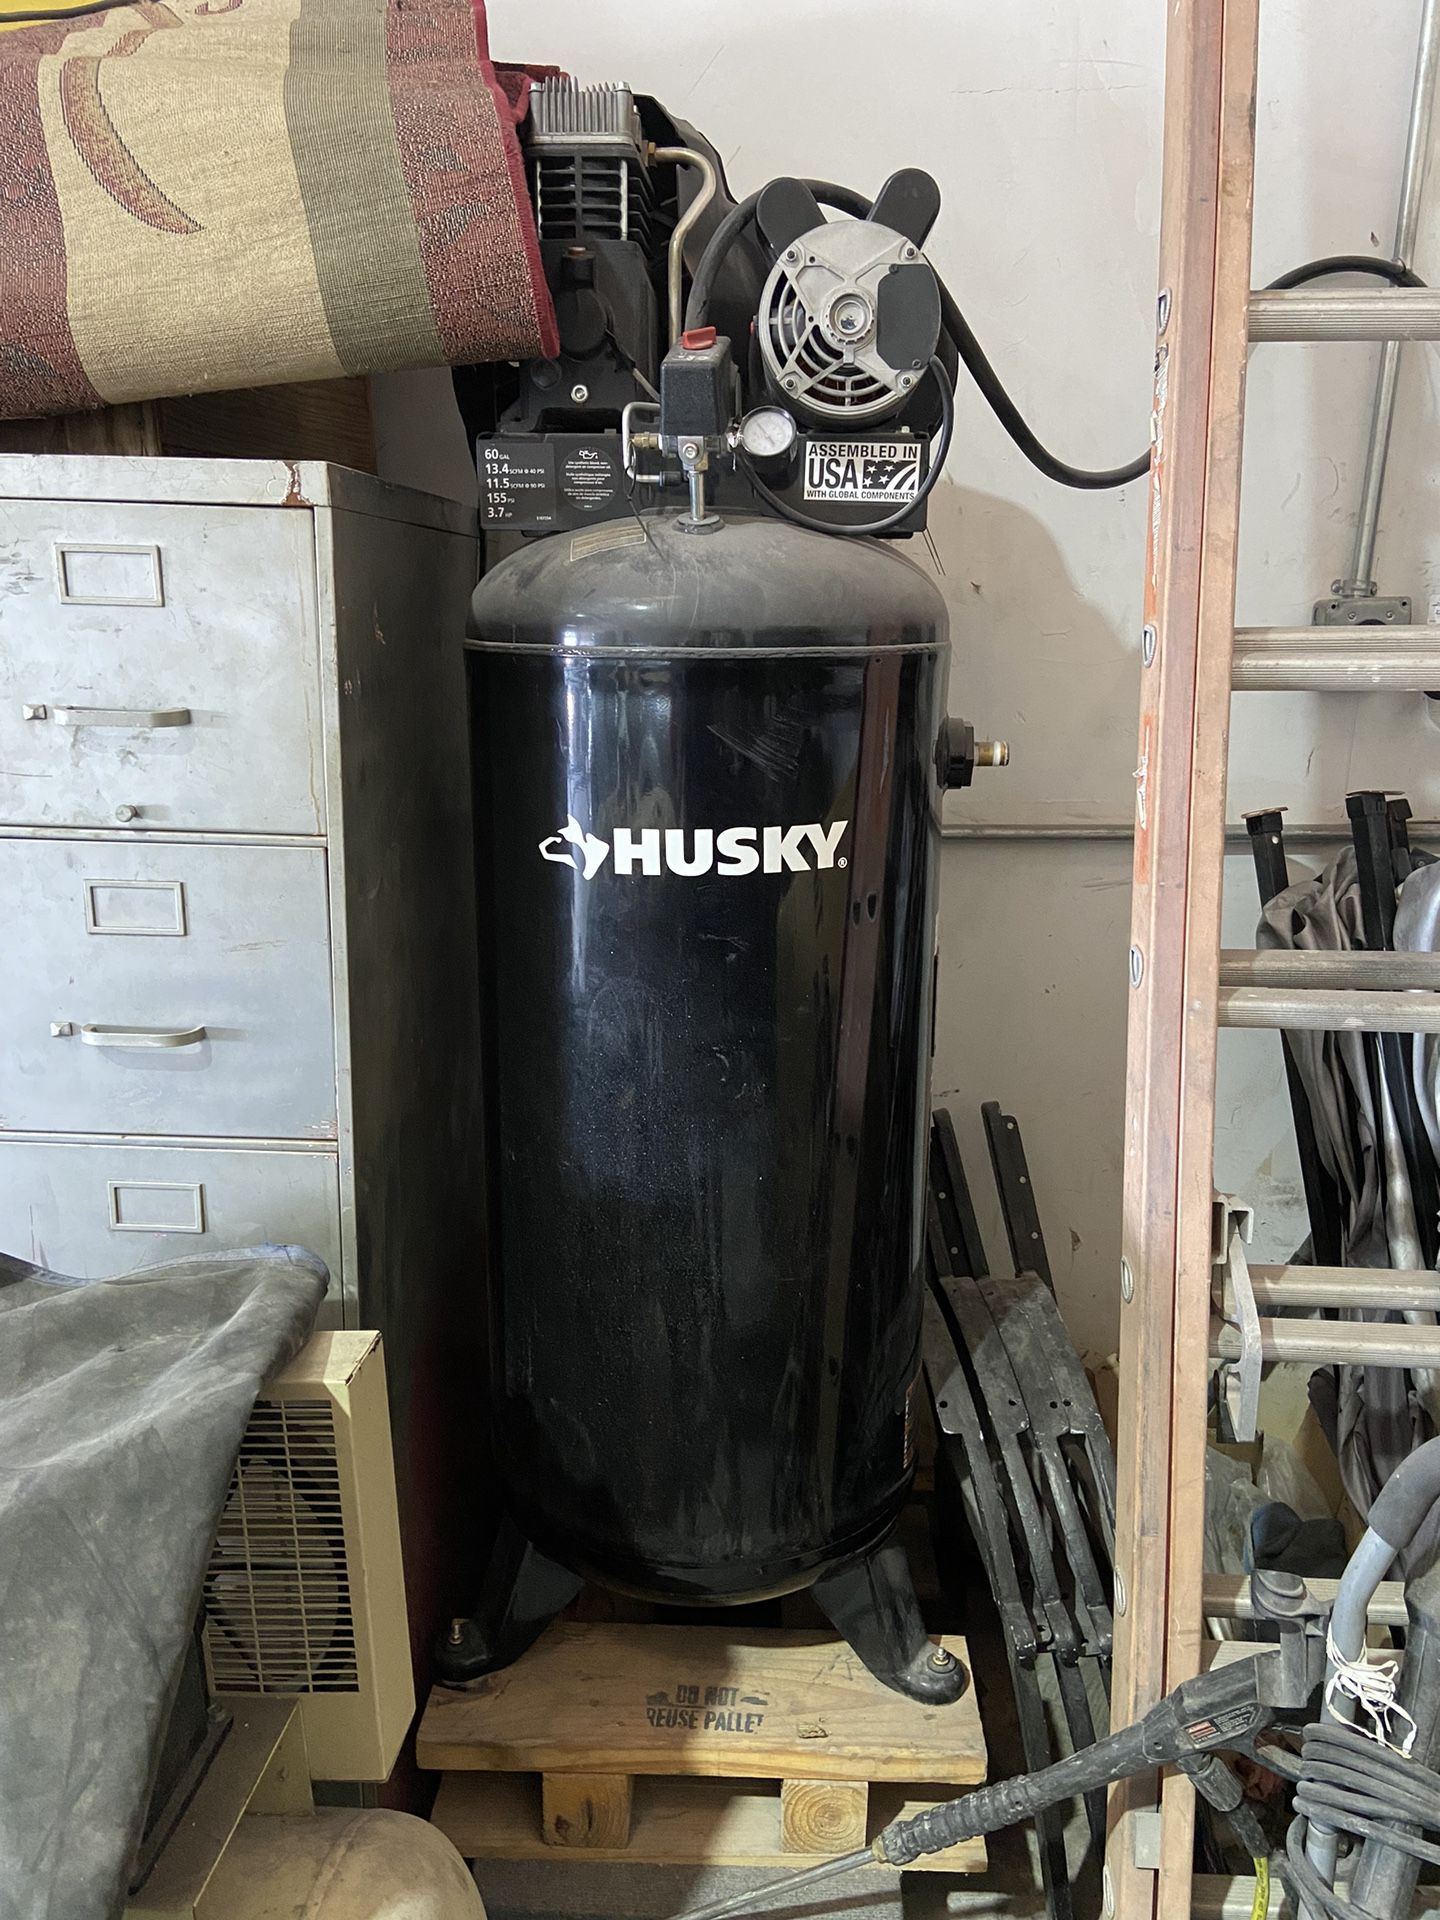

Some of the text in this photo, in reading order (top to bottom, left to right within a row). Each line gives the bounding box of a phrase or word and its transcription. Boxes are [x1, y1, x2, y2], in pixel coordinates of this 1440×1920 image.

[484, 448, 499, 460] 60
[809, 444, 918, 459] ASSEMBLED IN
[485, 463, 509, 475] 13.4
[808, 458, 858, 490] USA
[486, 478, 510, 489] 11.5
[487, 493, 507, 504] 155
[806, 489, 916, 501] WITH GLOBAL COMPONENTS
[487, 507, 505, 518] 3.7
[613, 820, 849, 877] HUSKY
[676, 1684, 740, 1707] DO NOT
[646, 1707, 699, 1730] REUSE
